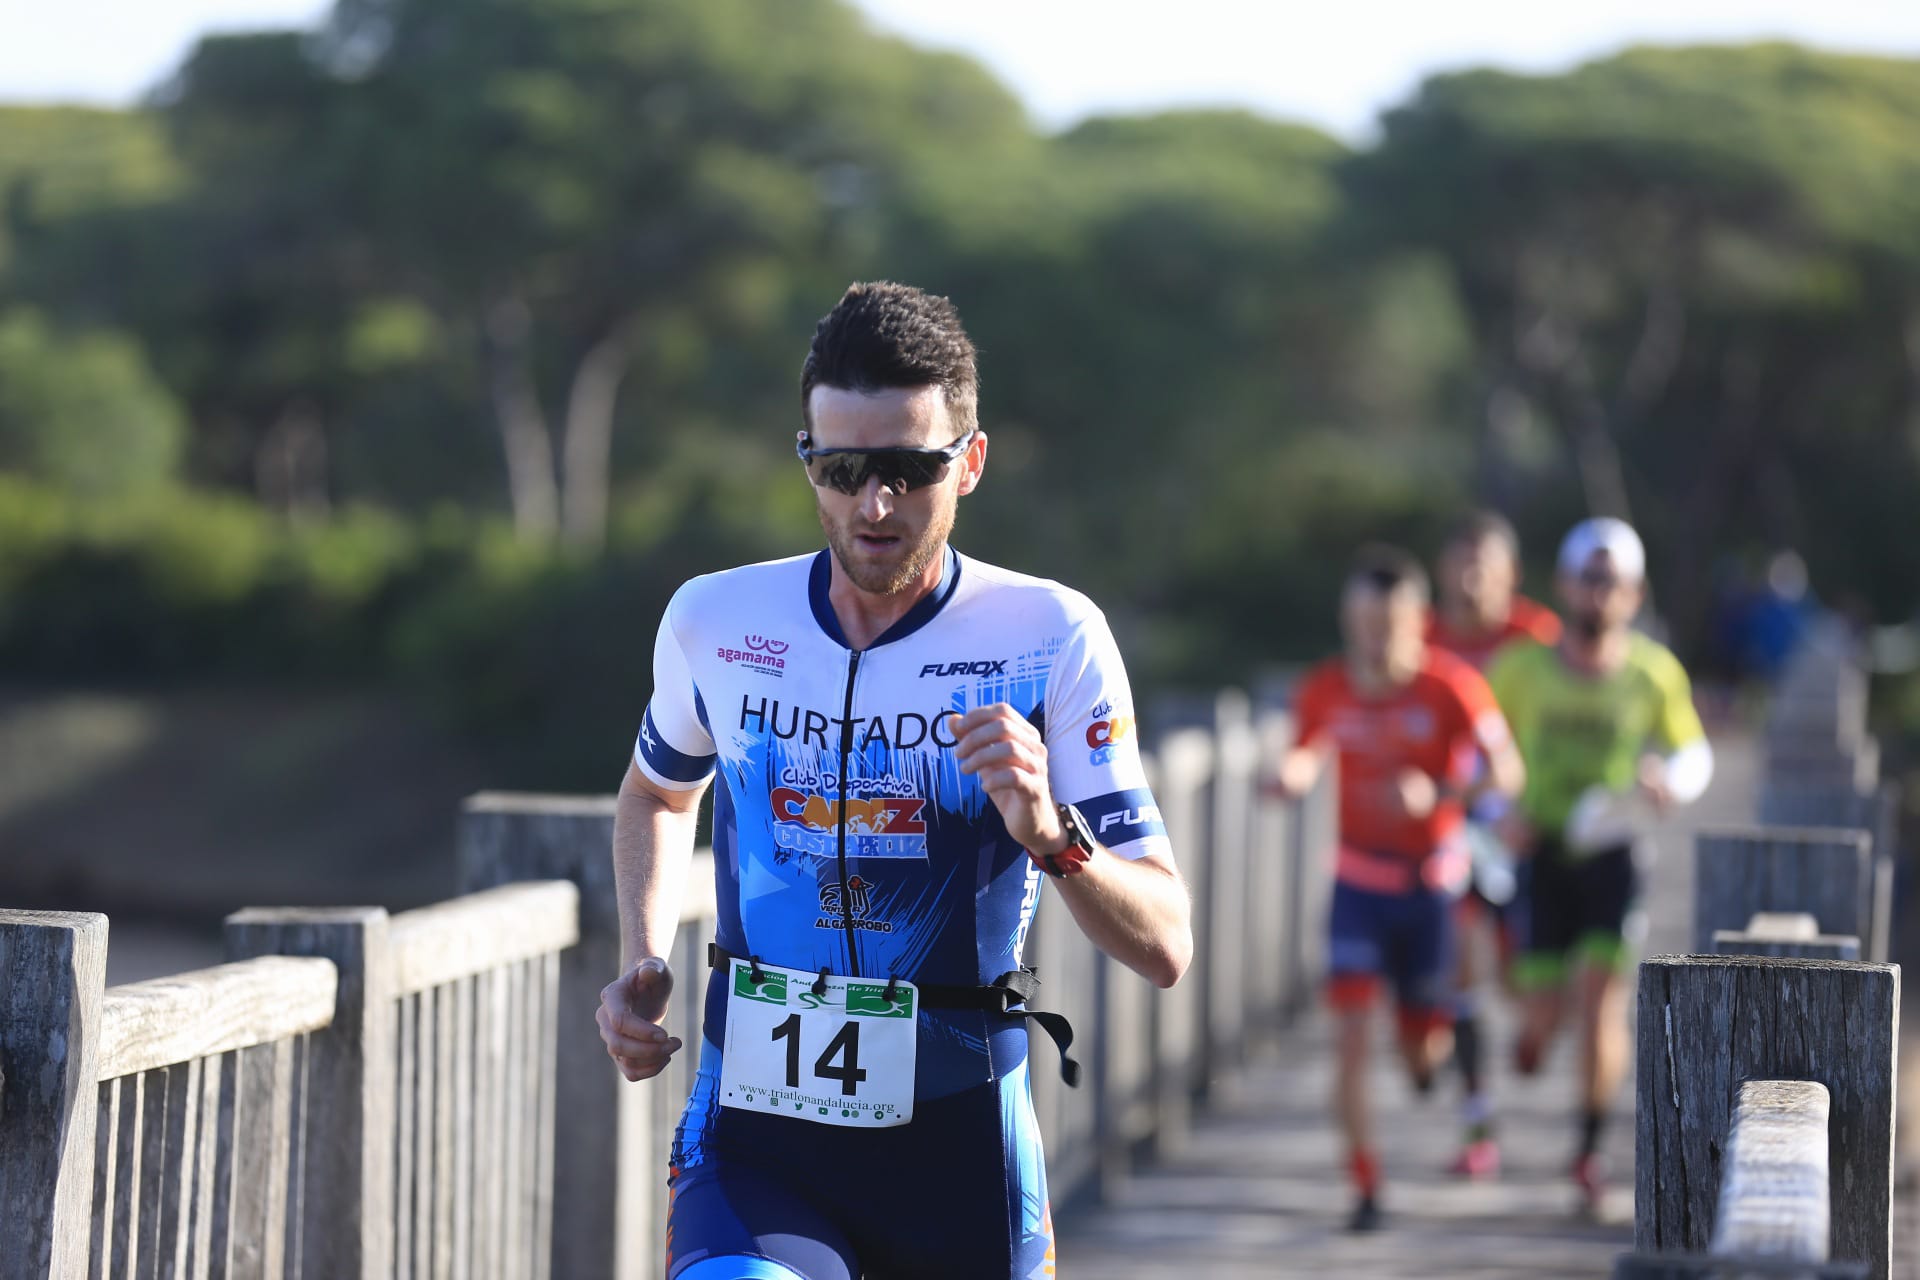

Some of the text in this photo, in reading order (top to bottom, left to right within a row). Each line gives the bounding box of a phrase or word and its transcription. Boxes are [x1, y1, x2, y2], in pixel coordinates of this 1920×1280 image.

[717, 647, 785, 669] agamama
[919, 659, 1008, 678] FURIOX
[1092, 702, 1112, 719] Club
[739, 694, 961, 753] HURTADO
[782, 767, 817, 786] Club
[771, 1012, 867, 1096] 14
[738, 1083, 896, 1113] www.triatlonandalucia.org
